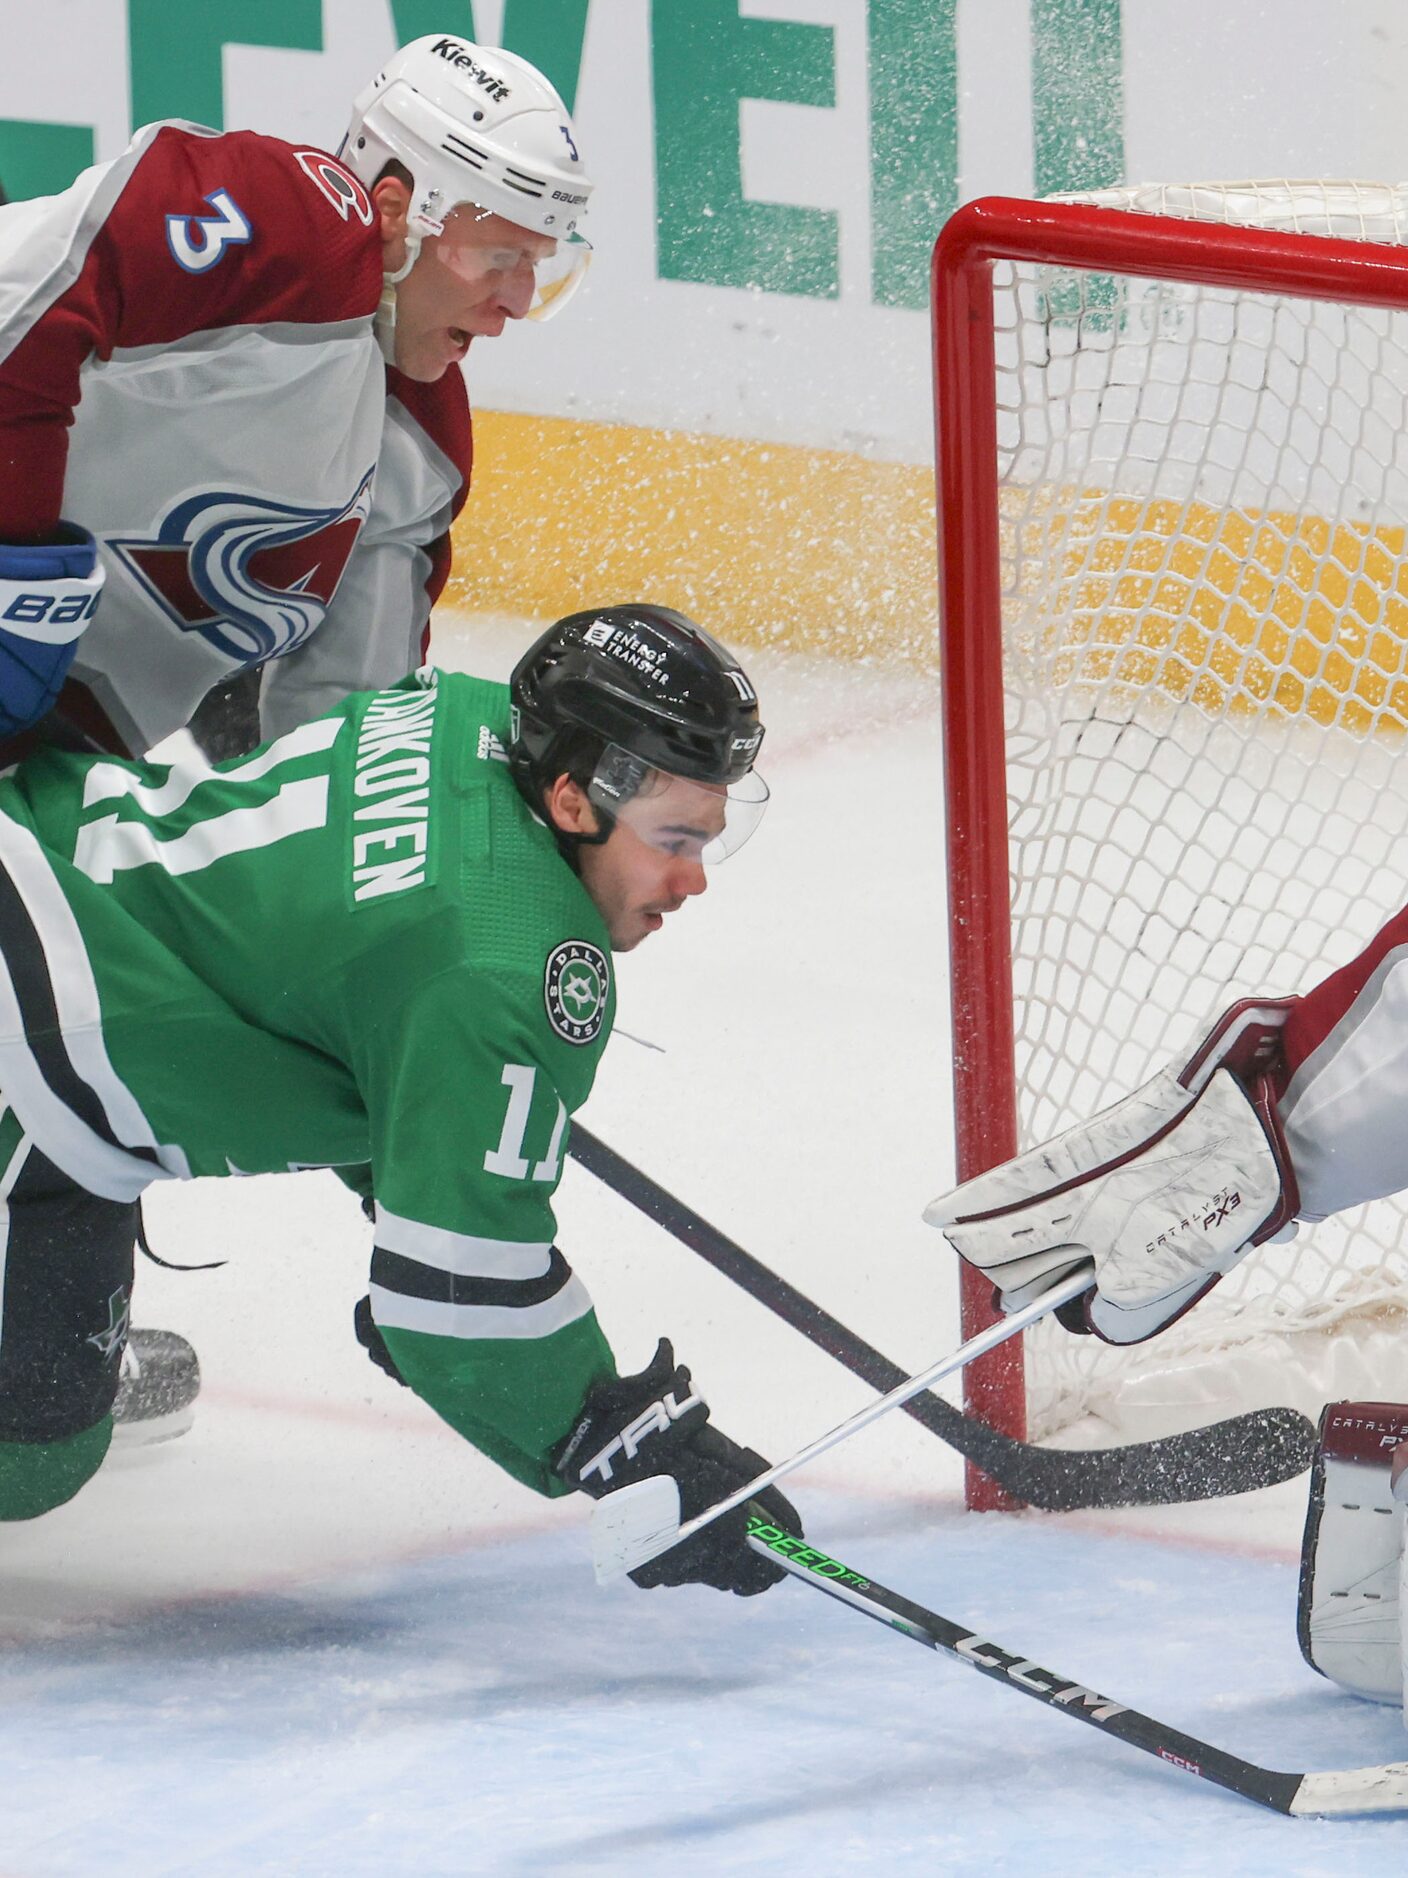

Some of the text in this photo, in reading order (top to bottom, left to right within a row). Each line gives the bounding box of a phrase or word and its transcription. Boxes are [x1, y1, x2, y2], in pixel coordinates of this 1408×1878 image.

[431, 38, 512, 103] Kiewit
[165, 188, 253, 275] 3
[606, 641, 670, 686] TRANSFER
[612, 629, 667, 666] ENERGY
[549, 984, 594, 1038] STARS
[483, 1063, 568, 1182] 11
[1145, 1186, 1228, 1254] CATALYST
[1203, 1191, 1241, 1231] PX3
[954, 1634, 1131, 1723] CCM
[1160, 1749, 1200, 1776] CCM
